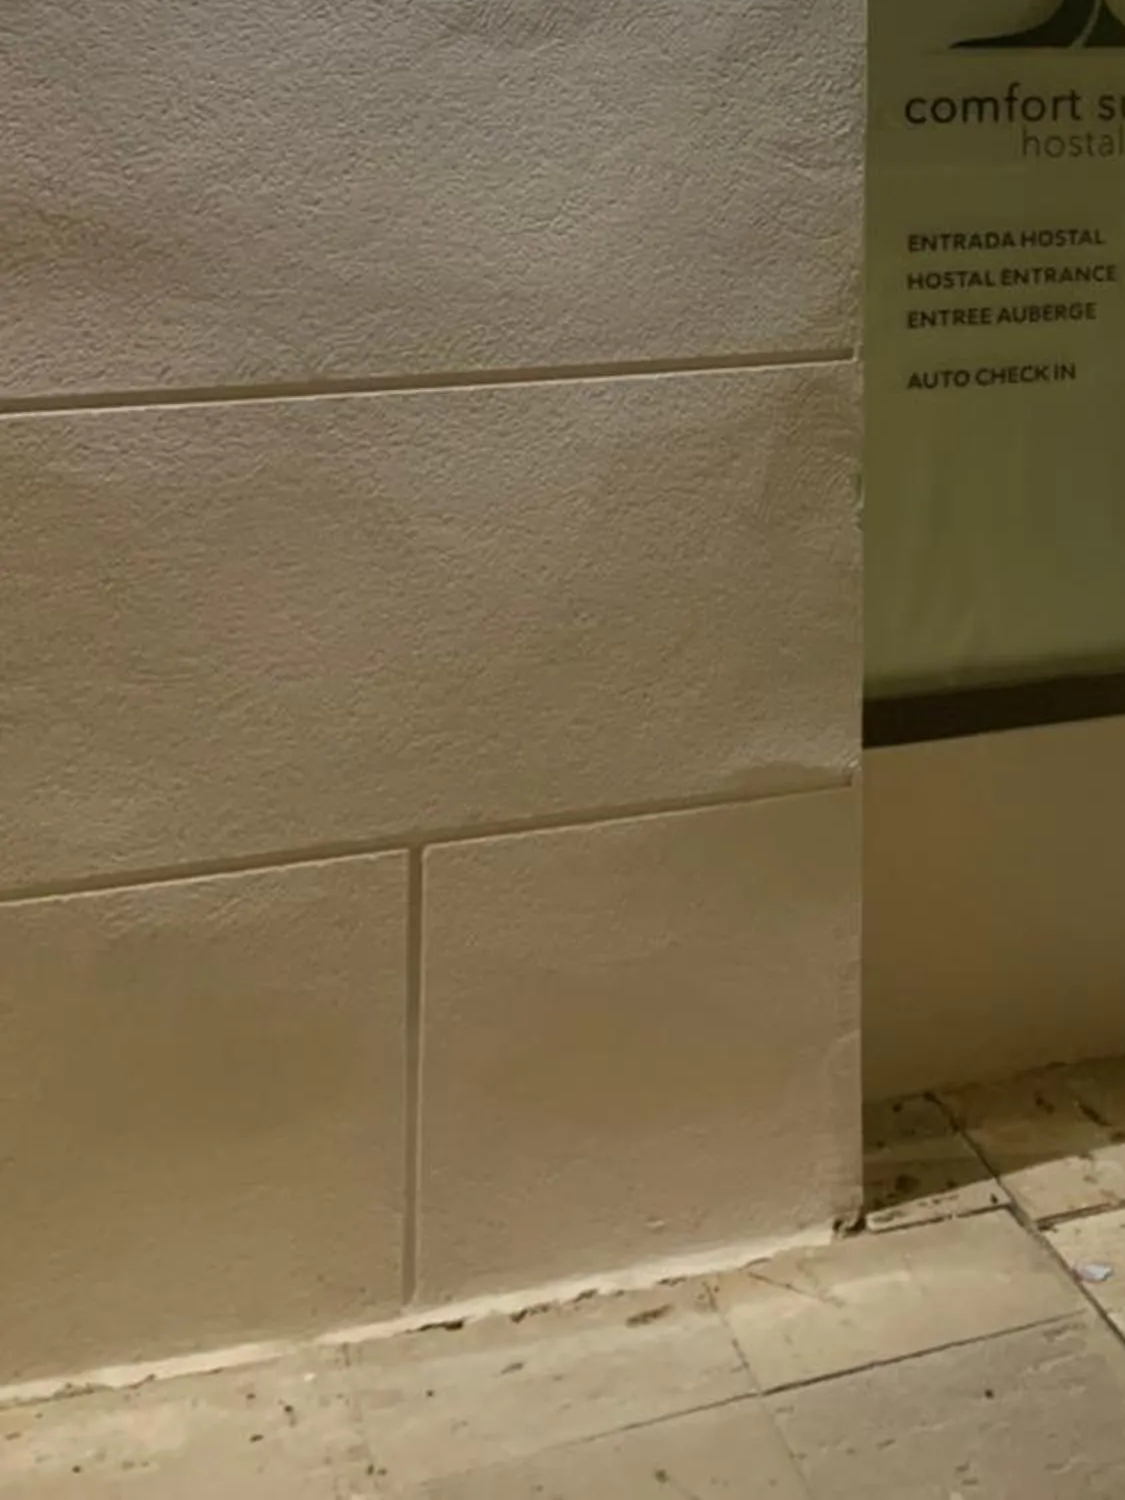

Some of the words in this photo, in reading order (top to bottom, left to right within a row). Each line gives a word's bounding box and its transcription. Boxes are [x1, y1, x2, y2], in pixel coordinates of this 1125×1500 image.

[905, 82, 1081, 124] comfort
[1021, 125, 1125, 158] hostal
[908, 232, 1016, 253] ENTRADA
[1021, 229, 1106, 249] HOSTAL
[908, 271, 996, 290] HOSTAL
[1002, 265, 1117, 286] ENTRANCE
[908, 308, 992, 329] ENTREE
[997, 302, 1097, 324] AUBERGE
[907, 369, 970, 389] AUTO
[975, 366, 1049, 386] CHECK
[1053, 364, 1076, 381] IN
